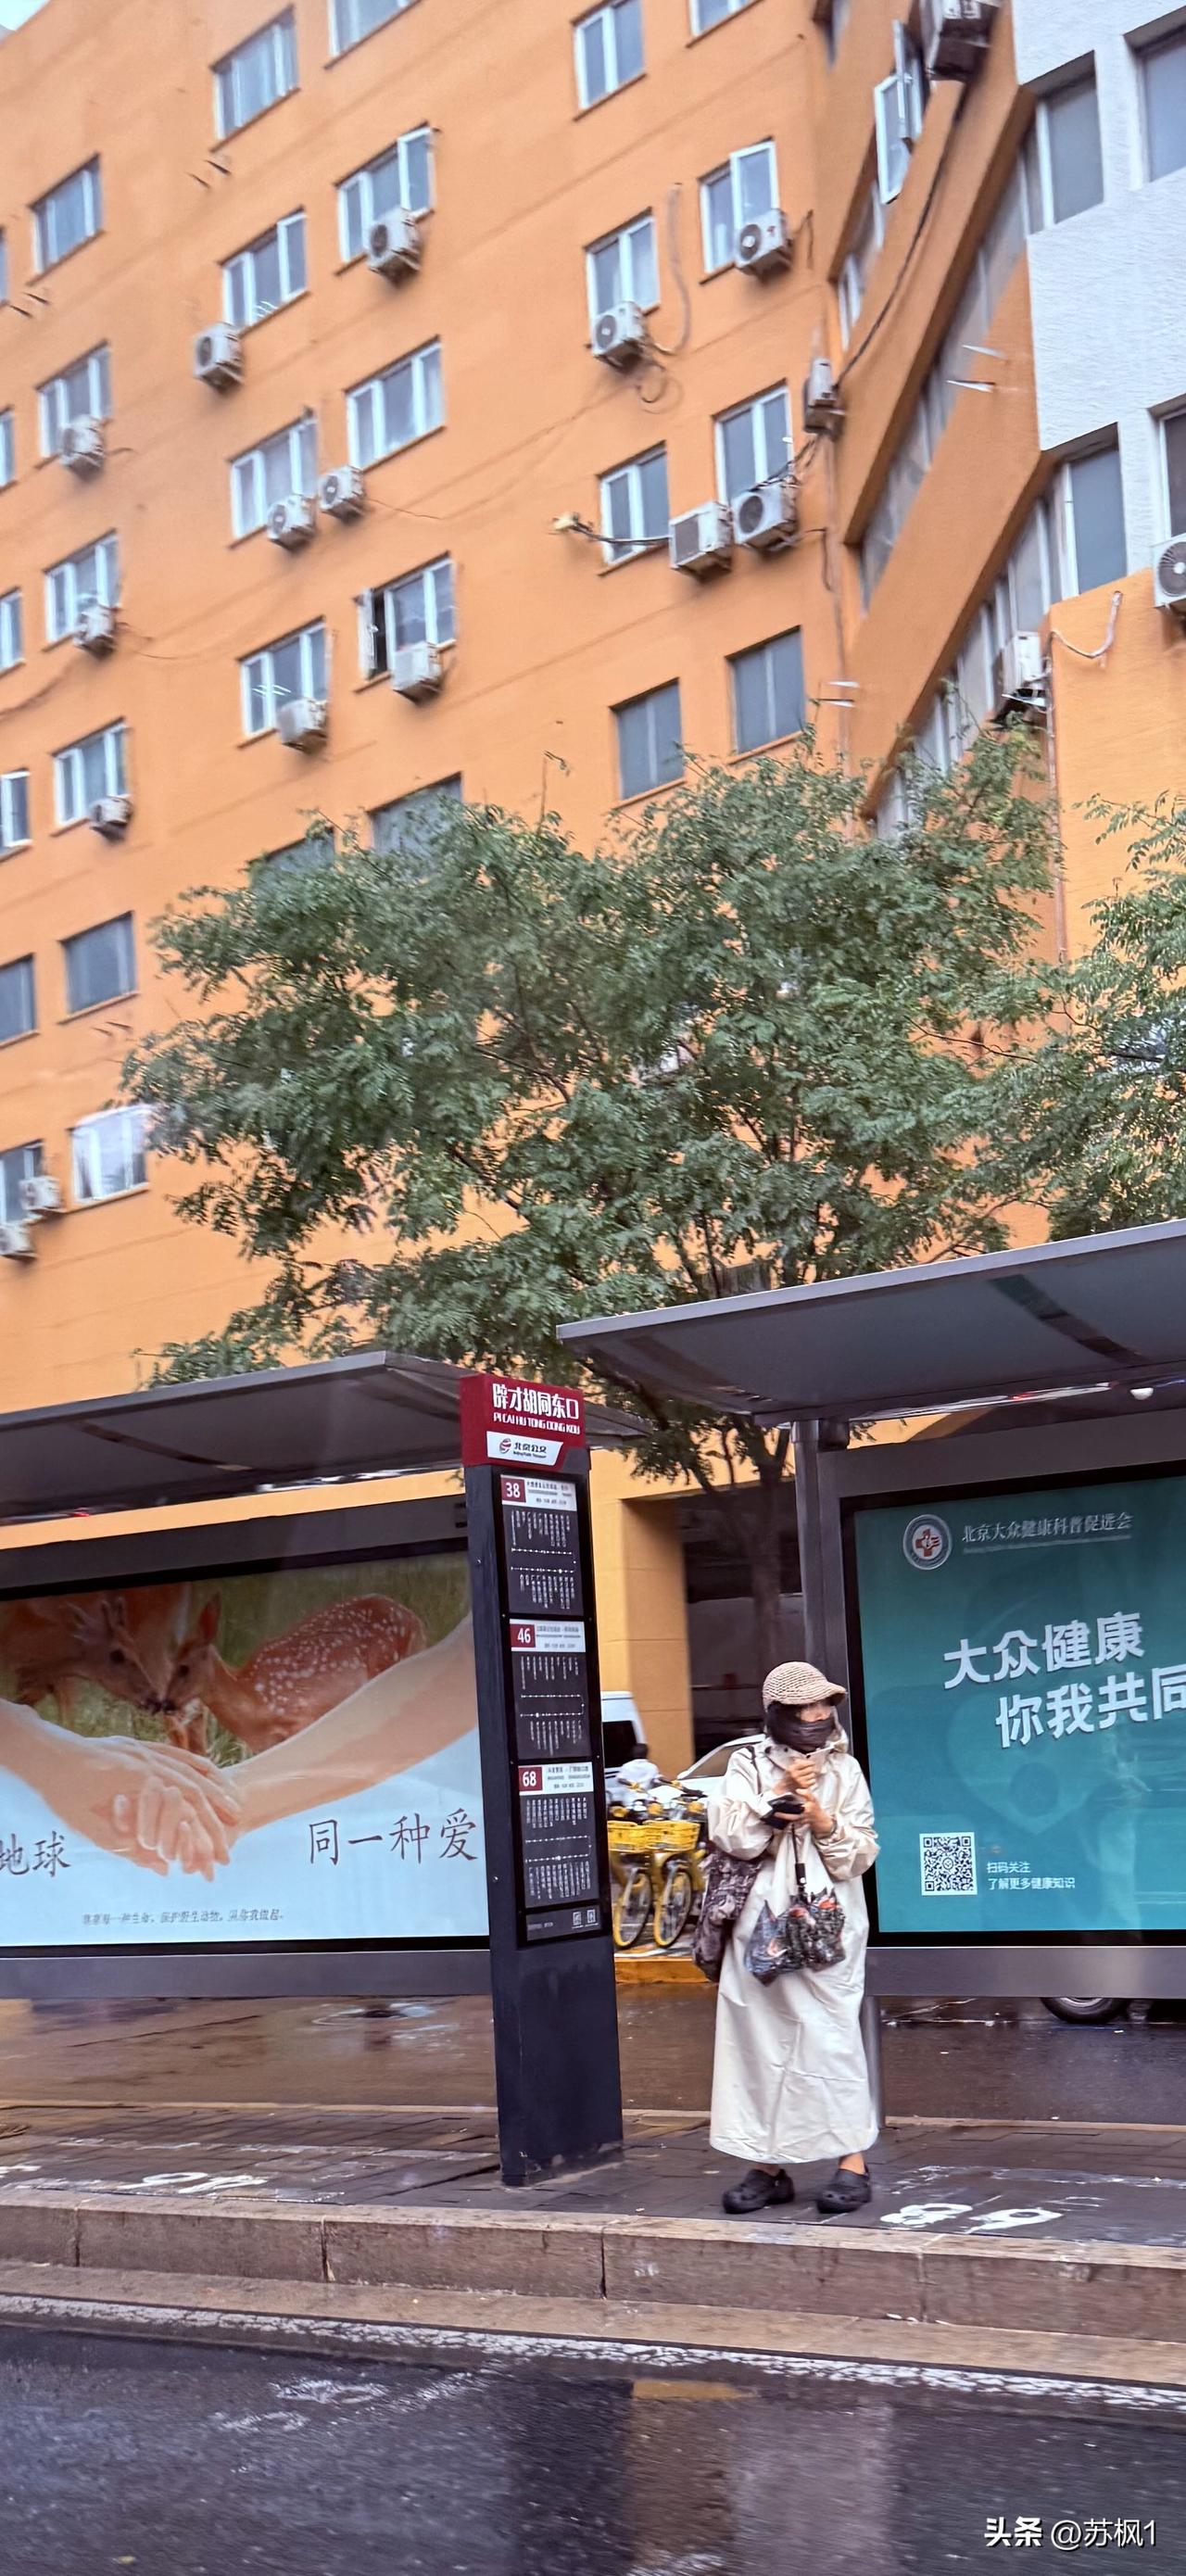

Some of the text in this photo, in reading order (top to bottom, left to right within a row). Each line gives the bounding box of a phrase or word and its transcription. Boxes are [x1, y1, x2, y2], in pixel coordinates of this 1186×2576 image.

[493, 1383, 579, 1420] 辟才胡同东口
[494, 1412, 581, 1435] PI CAI HU TONG DONG KOU
[505, 1482, 521, 1498] 38
[963, 1512, 1134, 1543] 北京大众健康科普促进会
[517, 1627, 531, 1644] 46
[943, 1611, 1145, 1689] 大众健康
[996, 1663, 1186, 1749] 你我共同
[523, 1771, 536, 1787] 68
[308, 1808, 479, 1865] 同一种爱
[987, 1861, 1030, 1874] 扫码关注
[987, 1877, 1076, 1890] 了解更多健康知识
